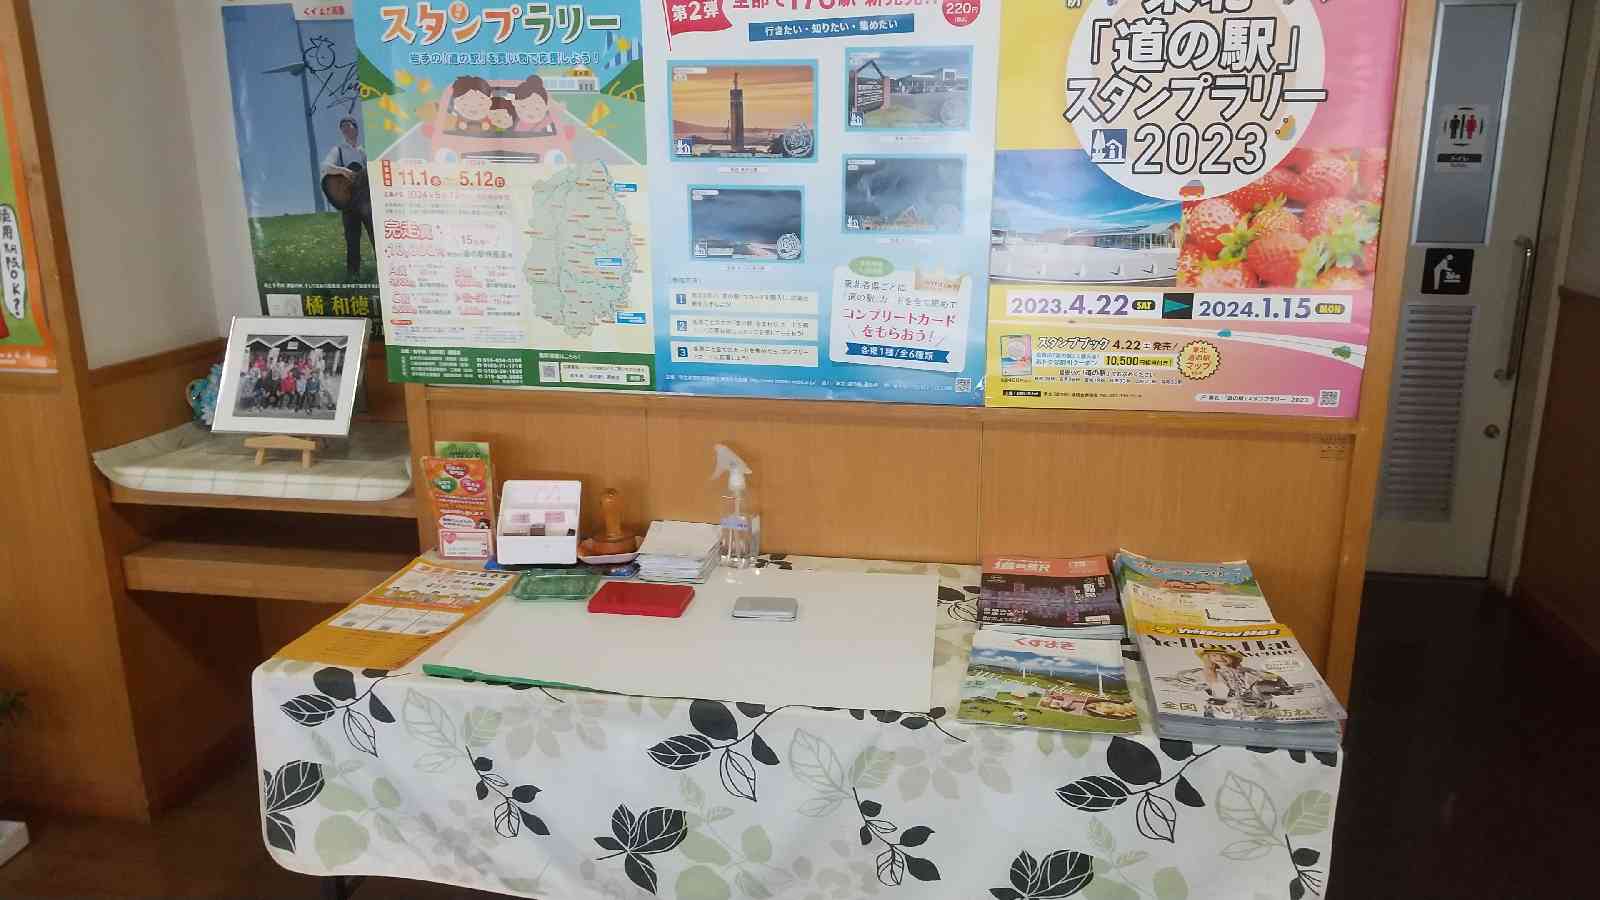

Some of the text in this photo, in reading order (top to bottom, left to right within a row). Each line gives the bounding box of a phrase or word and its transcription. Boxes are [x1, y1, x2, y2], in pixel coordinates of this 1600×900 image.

[380, 1, 621, 46] スタンプラリー
[672, 0, 719, 22] 第2弾
[946, 3, 978, 15] 220円
[1091, 17, 1300, 73] 「道の駅」
[1063, 72, 1328, 122] スタンプラリー
[1132, 123, 1267, 175] 2023
[1011, 294, 1128, 316] 2023.4.22
[1200, 297, 1311, 319] 2024.1.15
[1037, 336, 1111, 350] スタンプブック
[1112, 340, 1141, 350] 4.22
